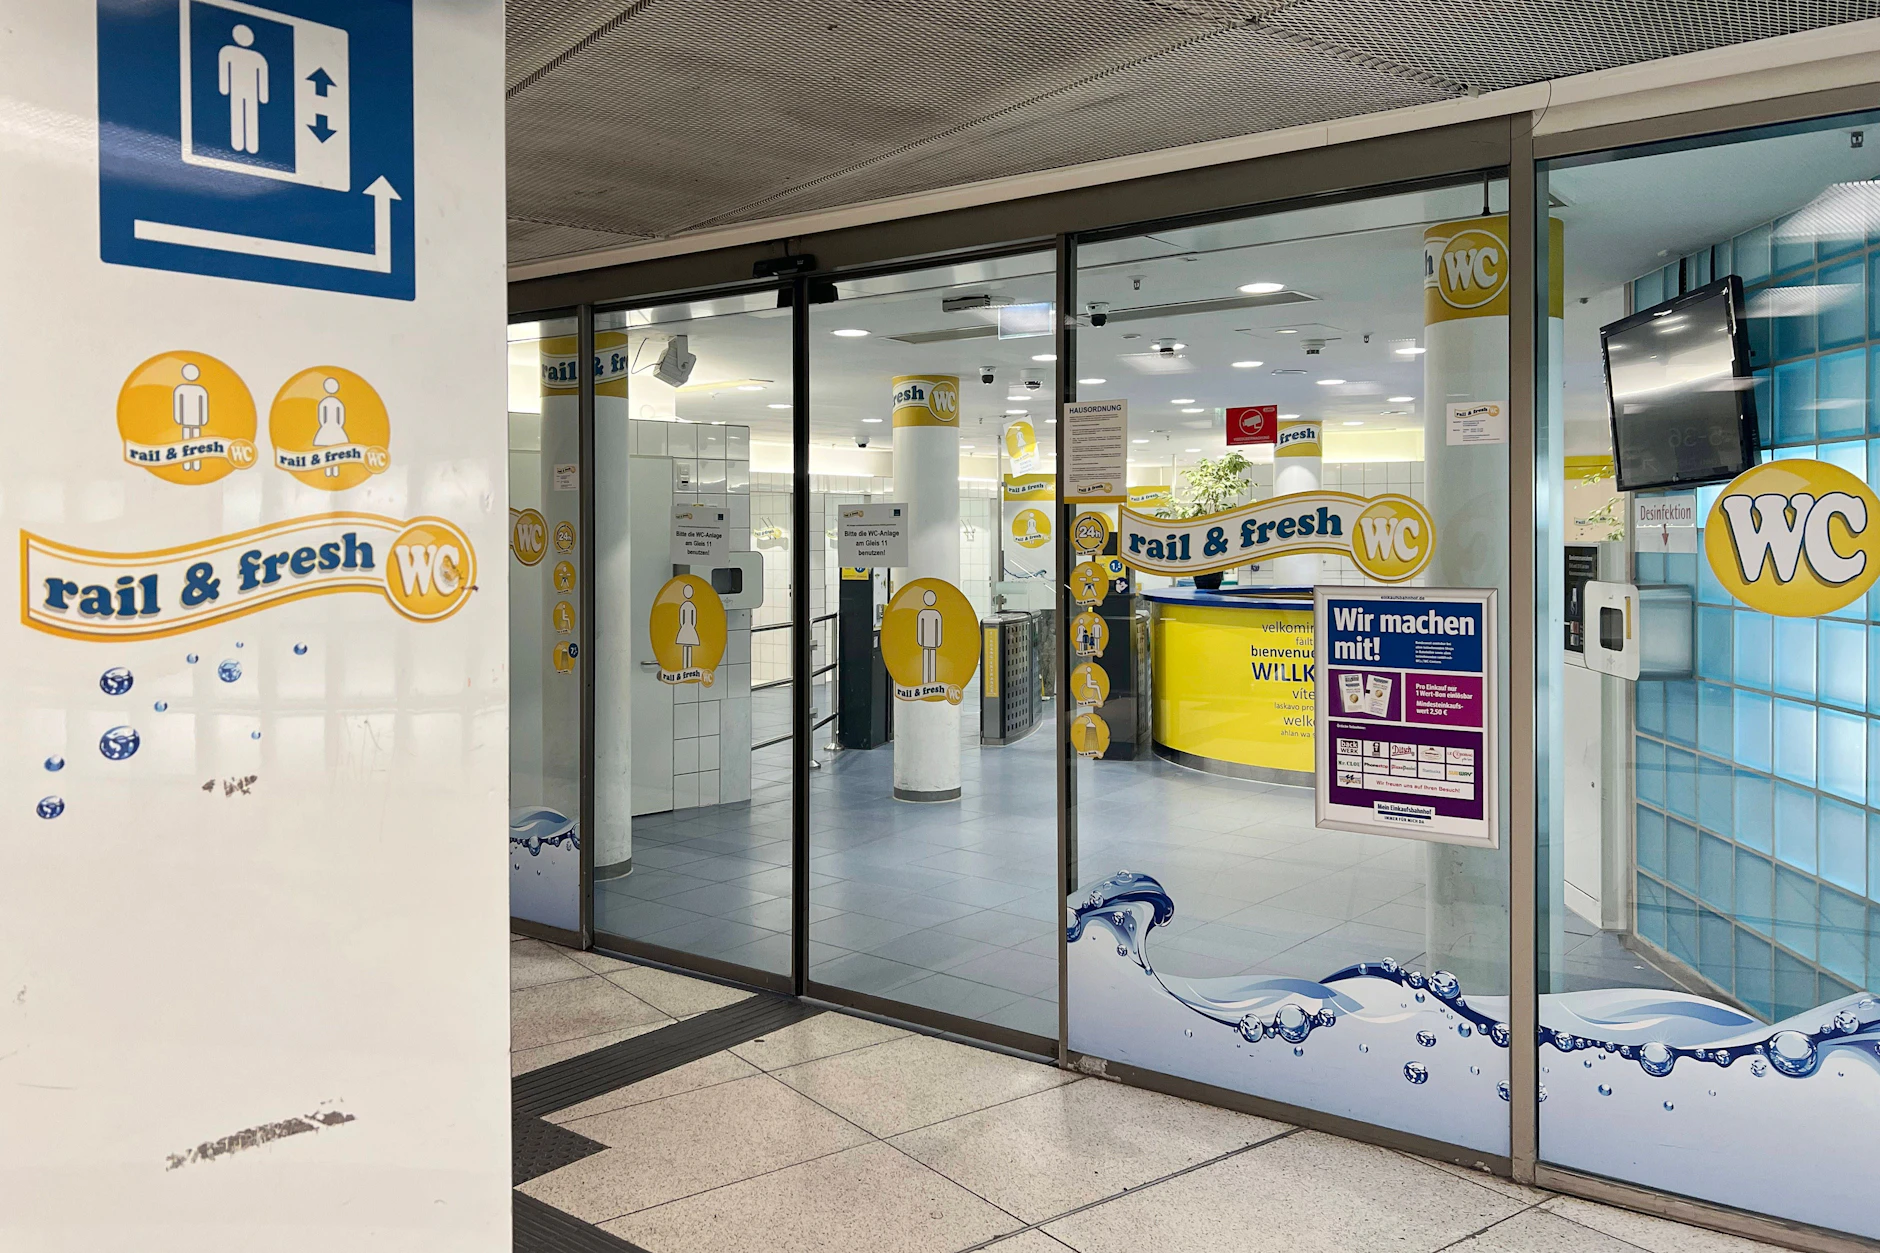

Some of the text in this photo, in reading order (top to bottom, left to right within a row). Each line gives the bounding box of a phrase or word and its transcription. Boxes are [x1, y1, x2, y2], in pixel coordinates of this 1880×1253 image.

[1443, 247, 1498, 292] WC
[542, 361, 578, 381] rail
[610, 353, 628, 373] fr
[932, 390, 956, 412] WC
[1069, 404, 1122, 414] HAUSORDNUNG
[1280, 428, 1316, 445] fresh
[130, 442, 252, 464] rail & fresh WC
[280, 448, 386, 467] rail & fresh WC
[1640, 503, 1692, 521] Desinfektion
[516, 523, 542, 553] WC
[1079, 525, 1101, 538] 24h
[1129, 506, 1420, 562] rail & fresh WC
[1719, 492, 1868, 588] WC
[44, 532, 461, 618] rail & fresh WC
[1334, 607, 1474, 636] Wir machen
[1334, 636, 1380, 662] mit!
[663, 673, 675, 681] rail
[683, 670, 700, 679] fresh
[897, 689, 912, 697] rail
[923, 685, 945, 695] fresh
[949, 689, 960, 700] WC
[1274, 702, 1300, 710] laskavo
[1416, 700, 1464, 709] Mindesteinkaufs-
[1283, 715, 1315, 727] welk
[1390, 805, 1432, 814] Einkaufsbahnhof
